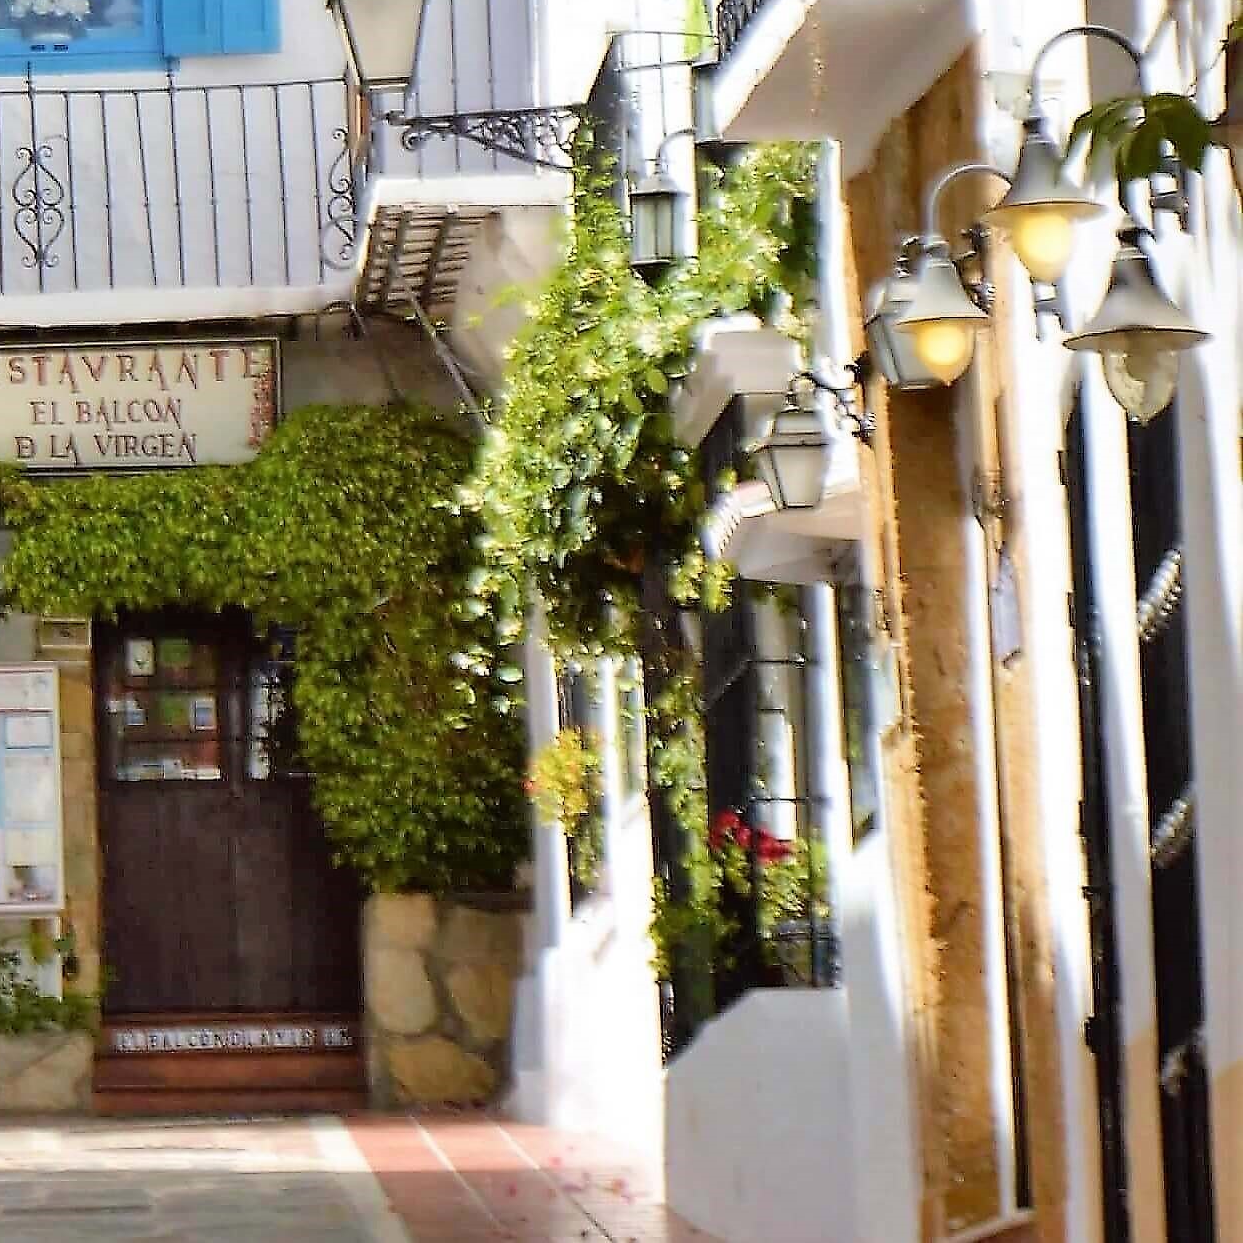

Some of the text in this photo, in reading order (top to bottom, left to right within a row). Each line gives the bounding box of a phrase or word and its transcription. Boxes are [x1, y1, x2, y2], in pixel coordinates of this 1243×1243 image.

[29, 395, 182, 430] EL BALCON
[49, 431, 80, 465] LA
[93, 431, 198, 463] VIRGEN
